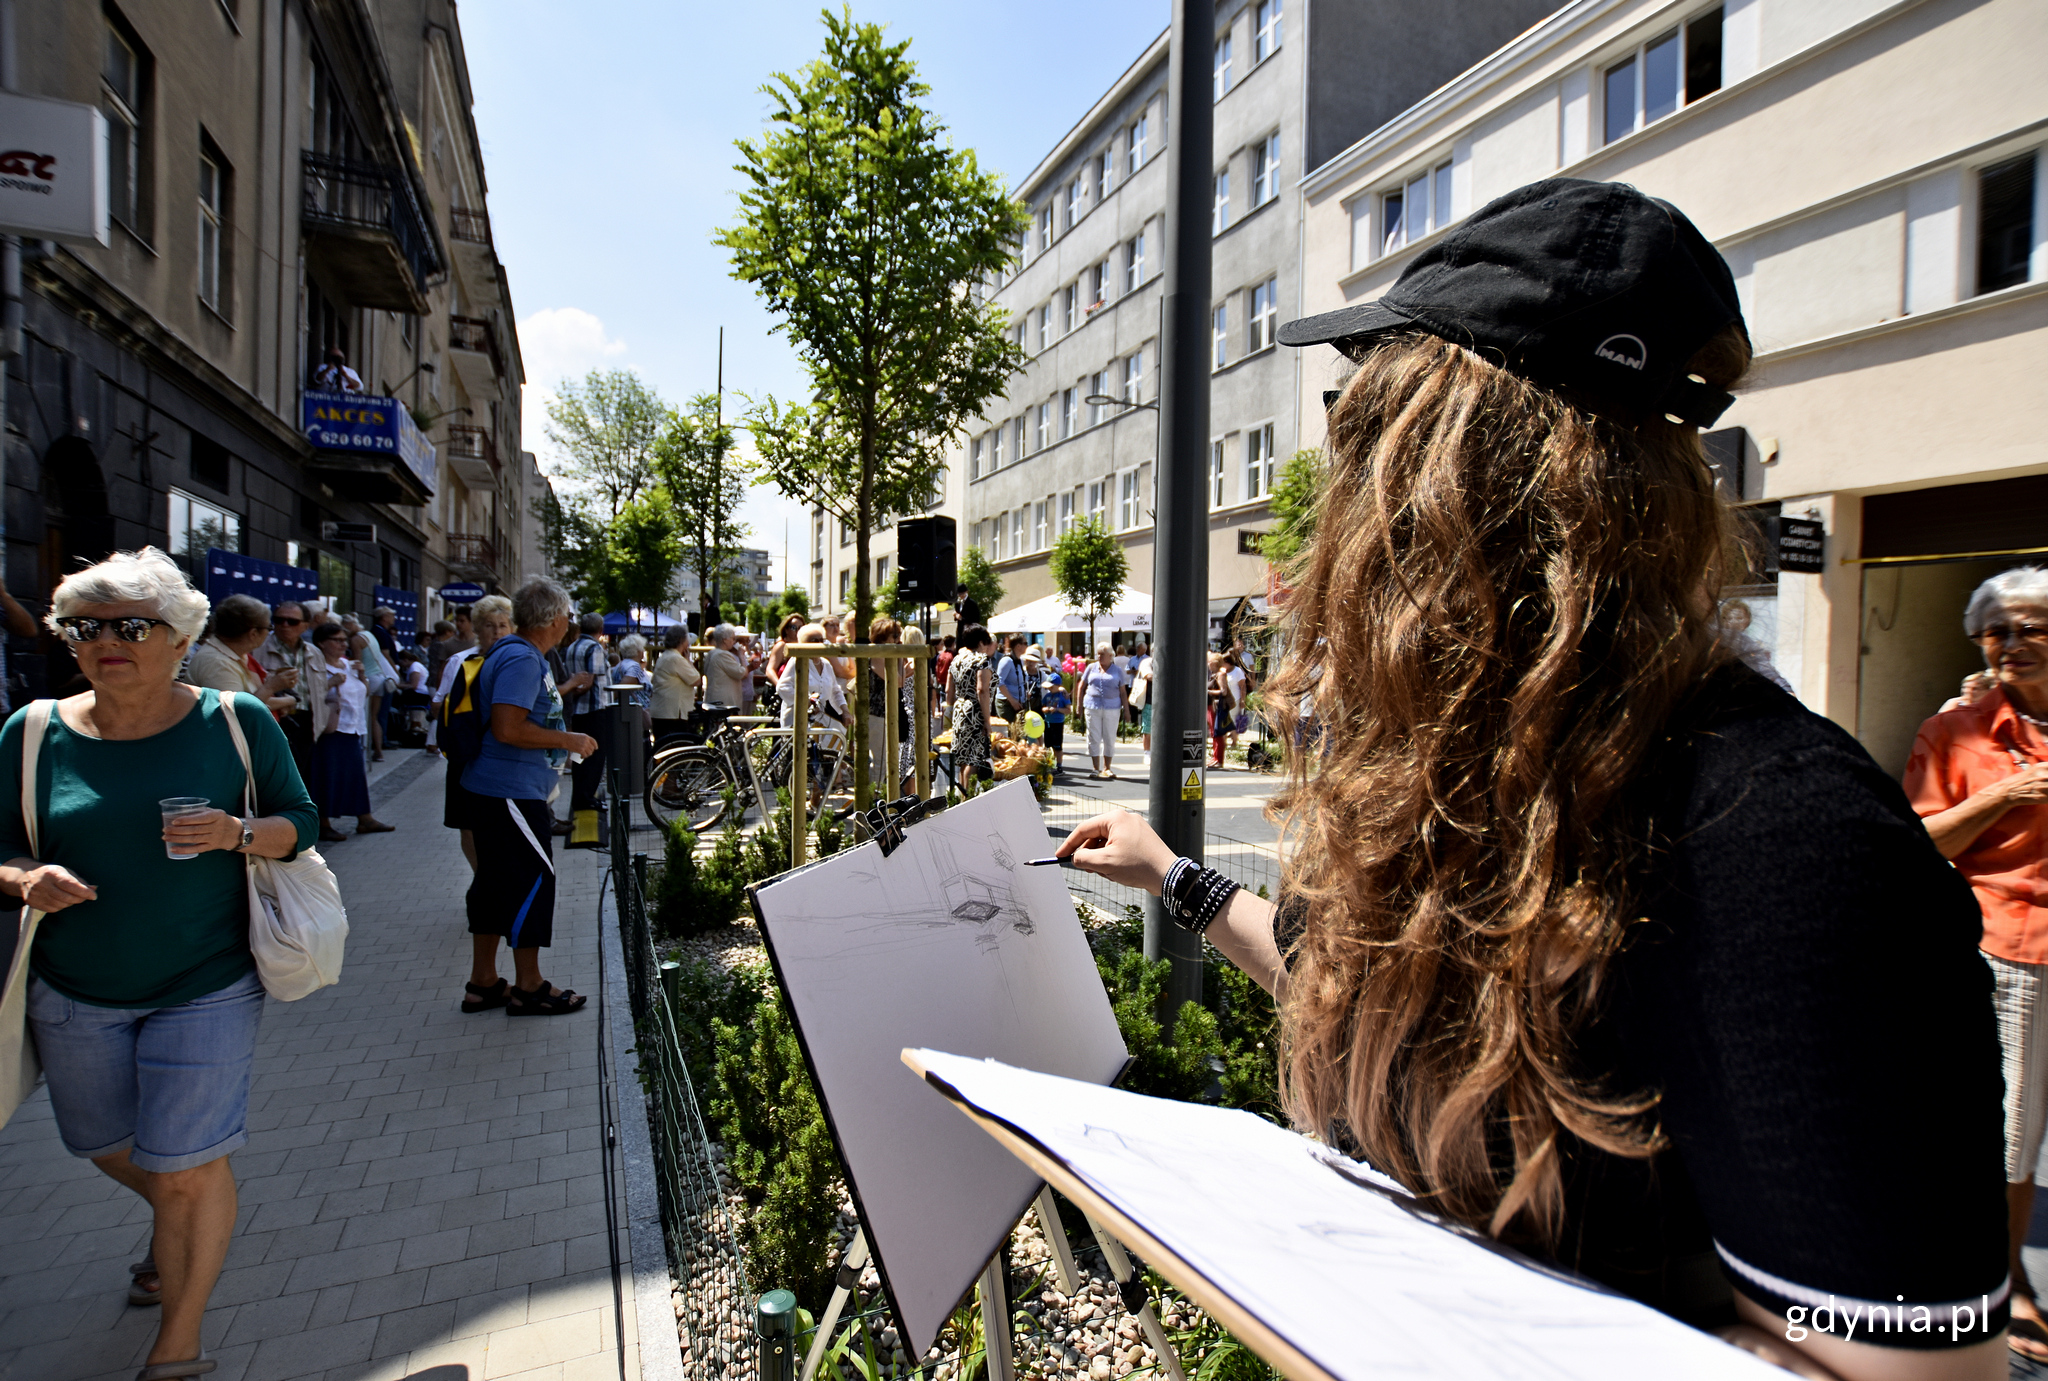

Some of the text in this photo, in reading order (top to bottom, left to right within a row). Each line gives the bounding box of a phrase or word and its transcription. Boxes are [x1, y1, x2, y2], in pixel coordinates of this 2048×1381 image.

[1600, 348, 1641, 369] MAN
[314, 406, 385, 426] AKCES
[320, 431, 394, 449] 620 60 70
